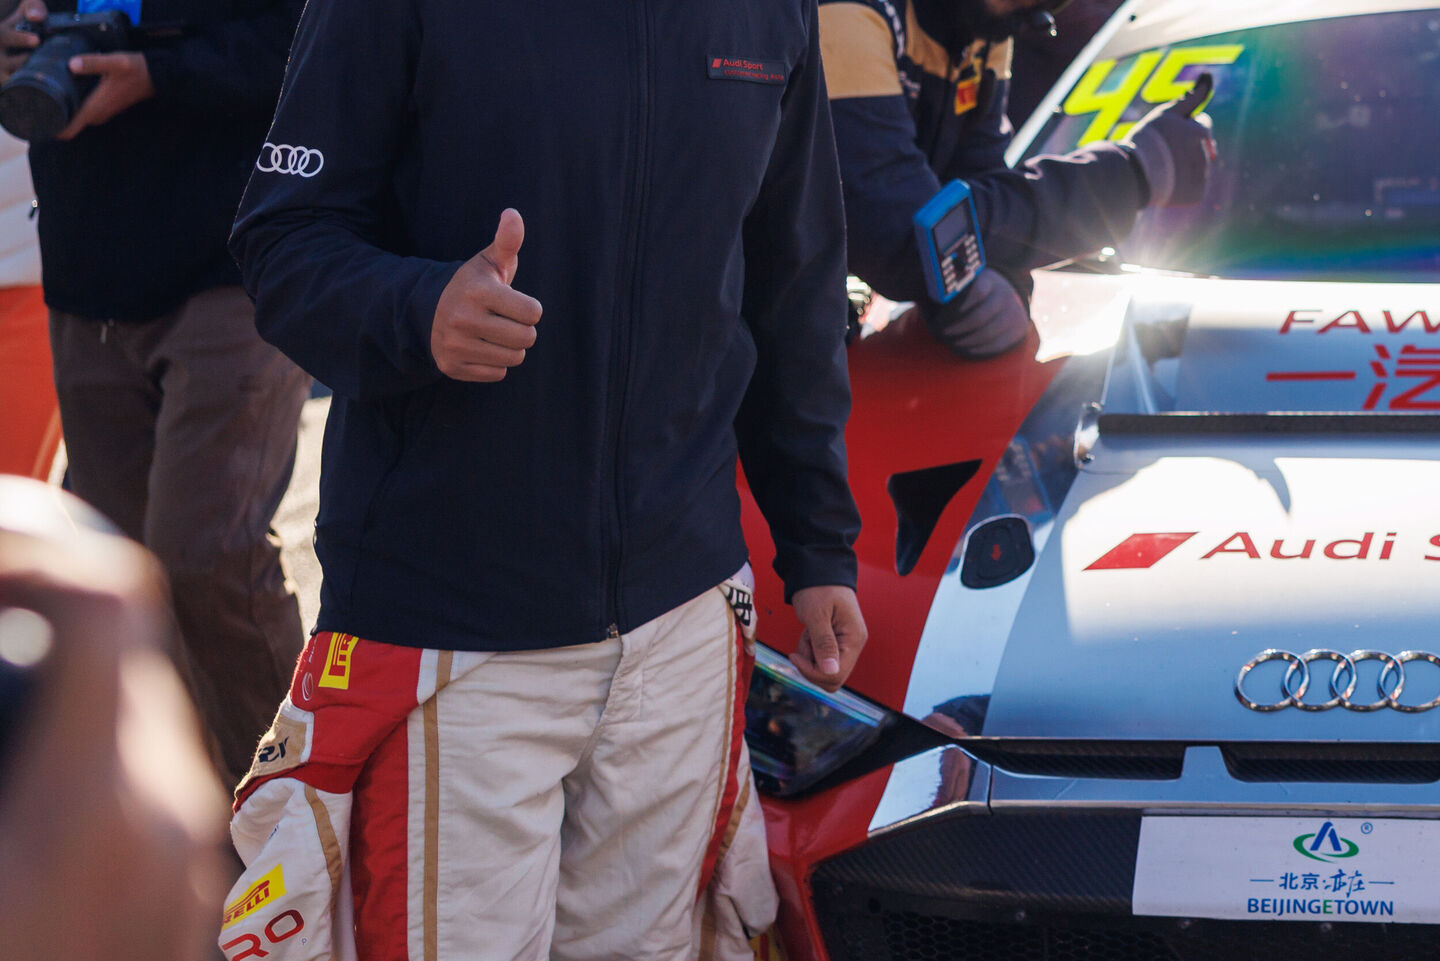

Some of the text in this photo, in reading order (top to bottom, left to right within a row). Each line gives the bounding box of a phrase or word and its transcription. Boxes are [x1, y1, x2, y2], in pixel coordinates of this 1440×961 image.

[722, 58, 763, 71] Audi Sport
[1200, 531, 1398, 561] Audi
[1247, 897, 1394, 916] BEIJINGETOWN
